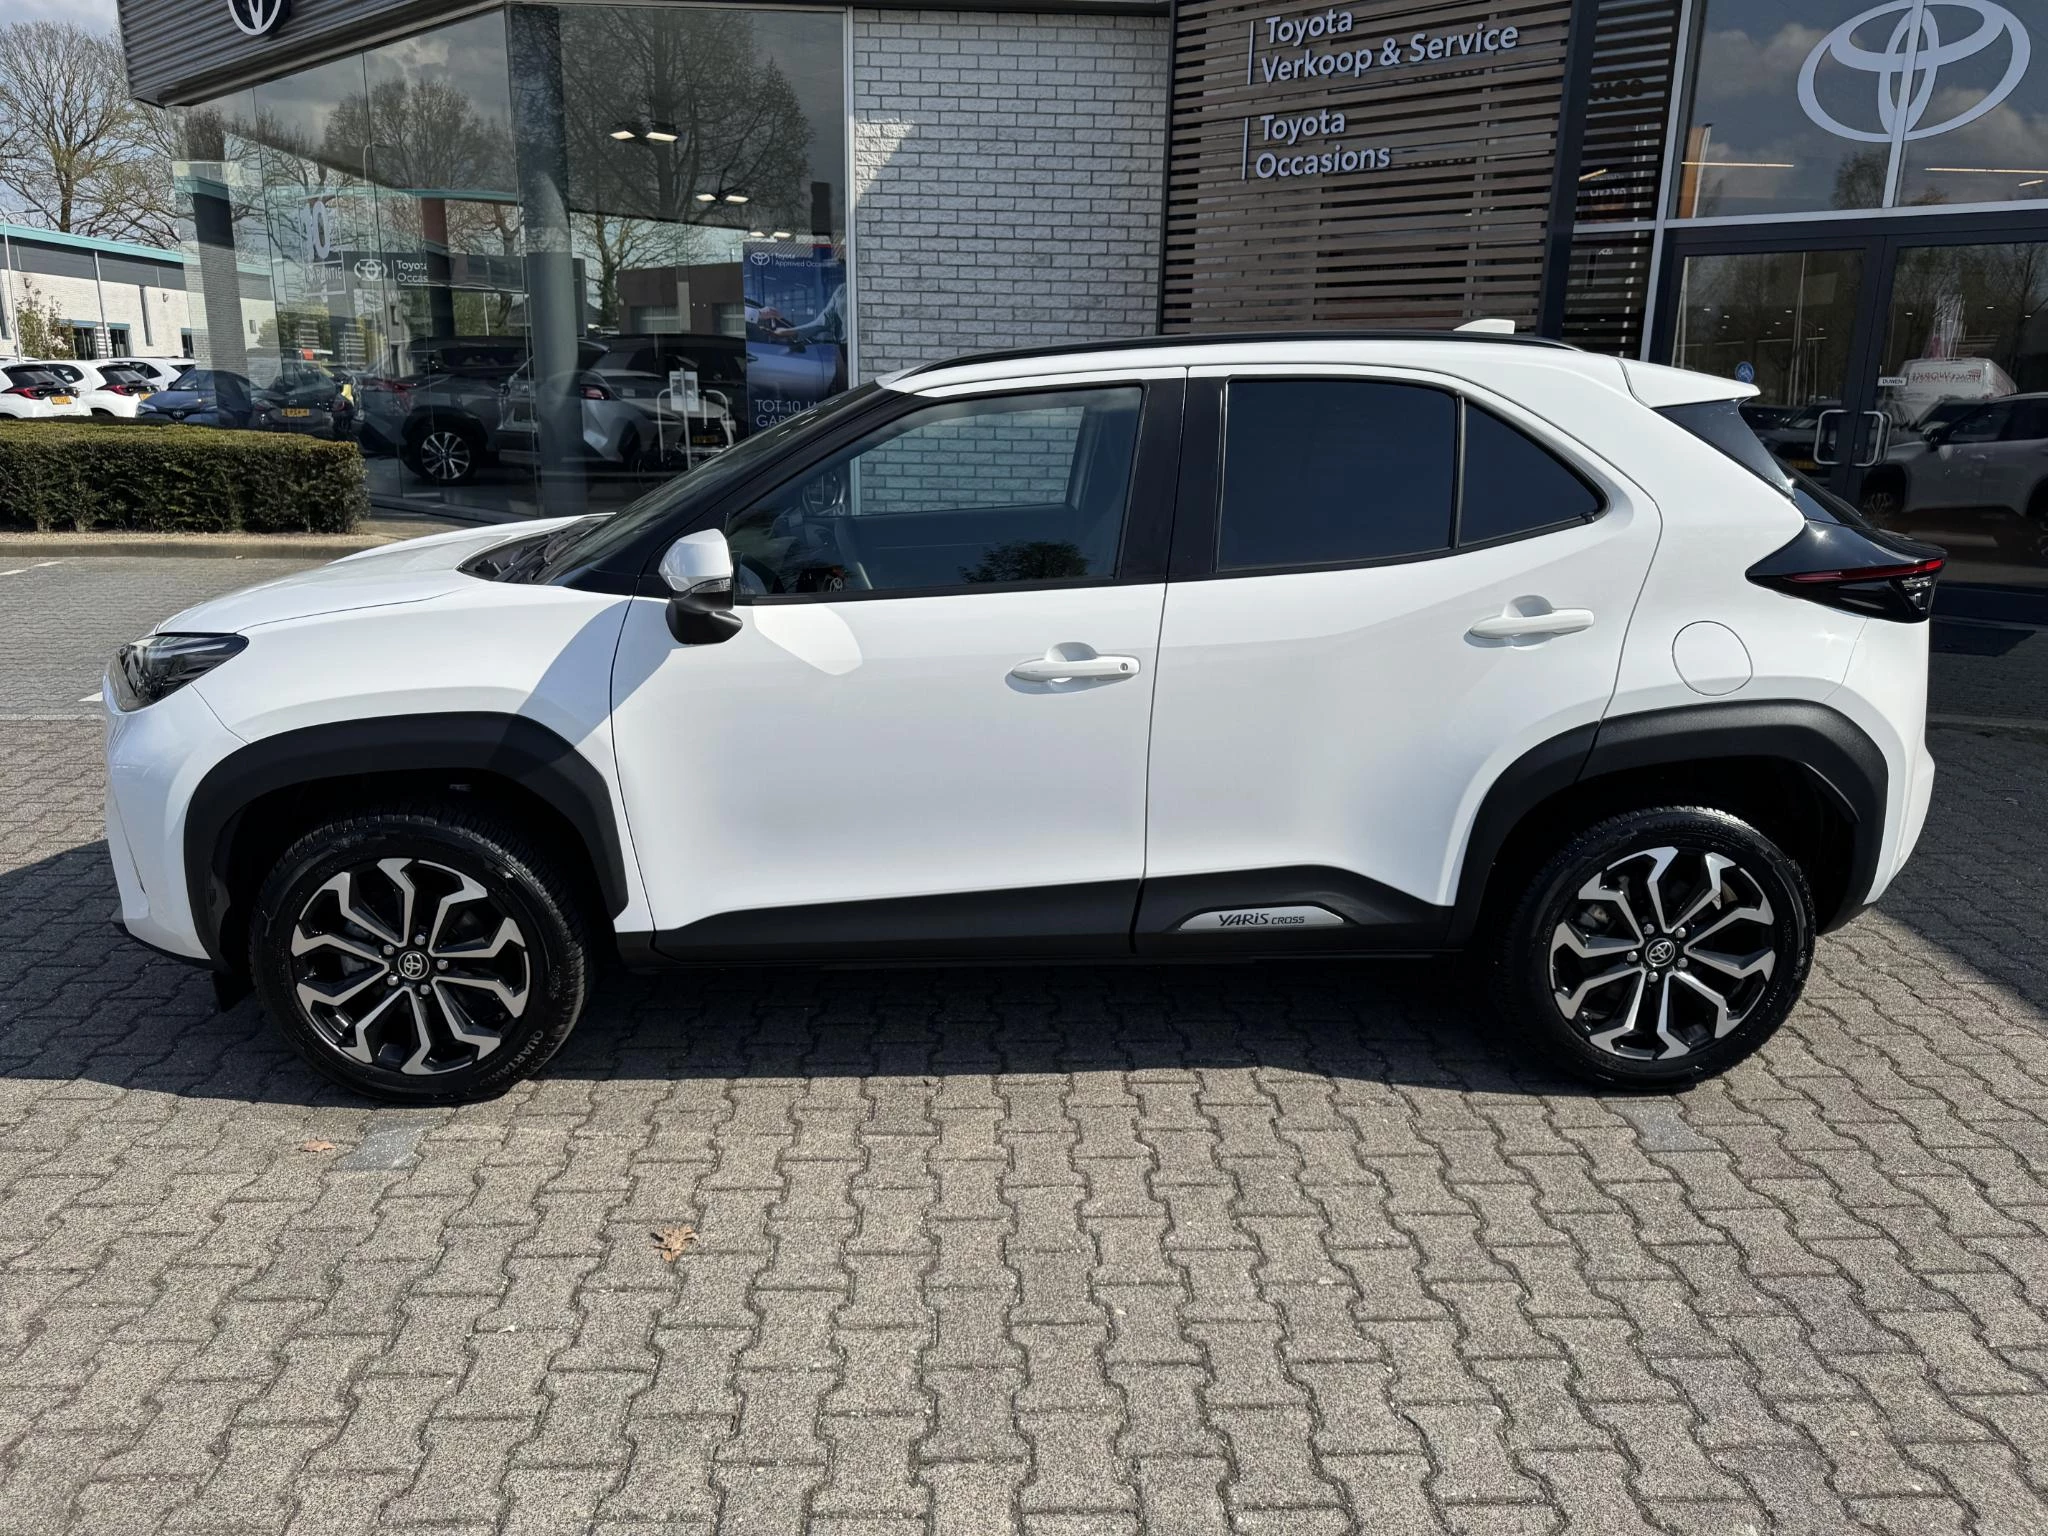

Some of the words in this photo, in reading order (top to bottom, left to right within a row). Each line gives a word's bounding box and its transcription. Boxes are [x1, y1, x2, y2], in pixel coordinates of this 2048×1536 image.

[1265, 8, 1353, 46] Toyota
[1261, 48, 1373, 83] Verkoop
[1379, 38, 1402, 66] &
[1409, 23, 1519, 62] Service
[1259, 108, 1345, 144] Toyota
[1255, 144, 1391, 179] Occasions
[755, 399, 782, 413] TOT
[786, 400, 801, 413] 10
[1271, 915, 1305, 925] CROSS
